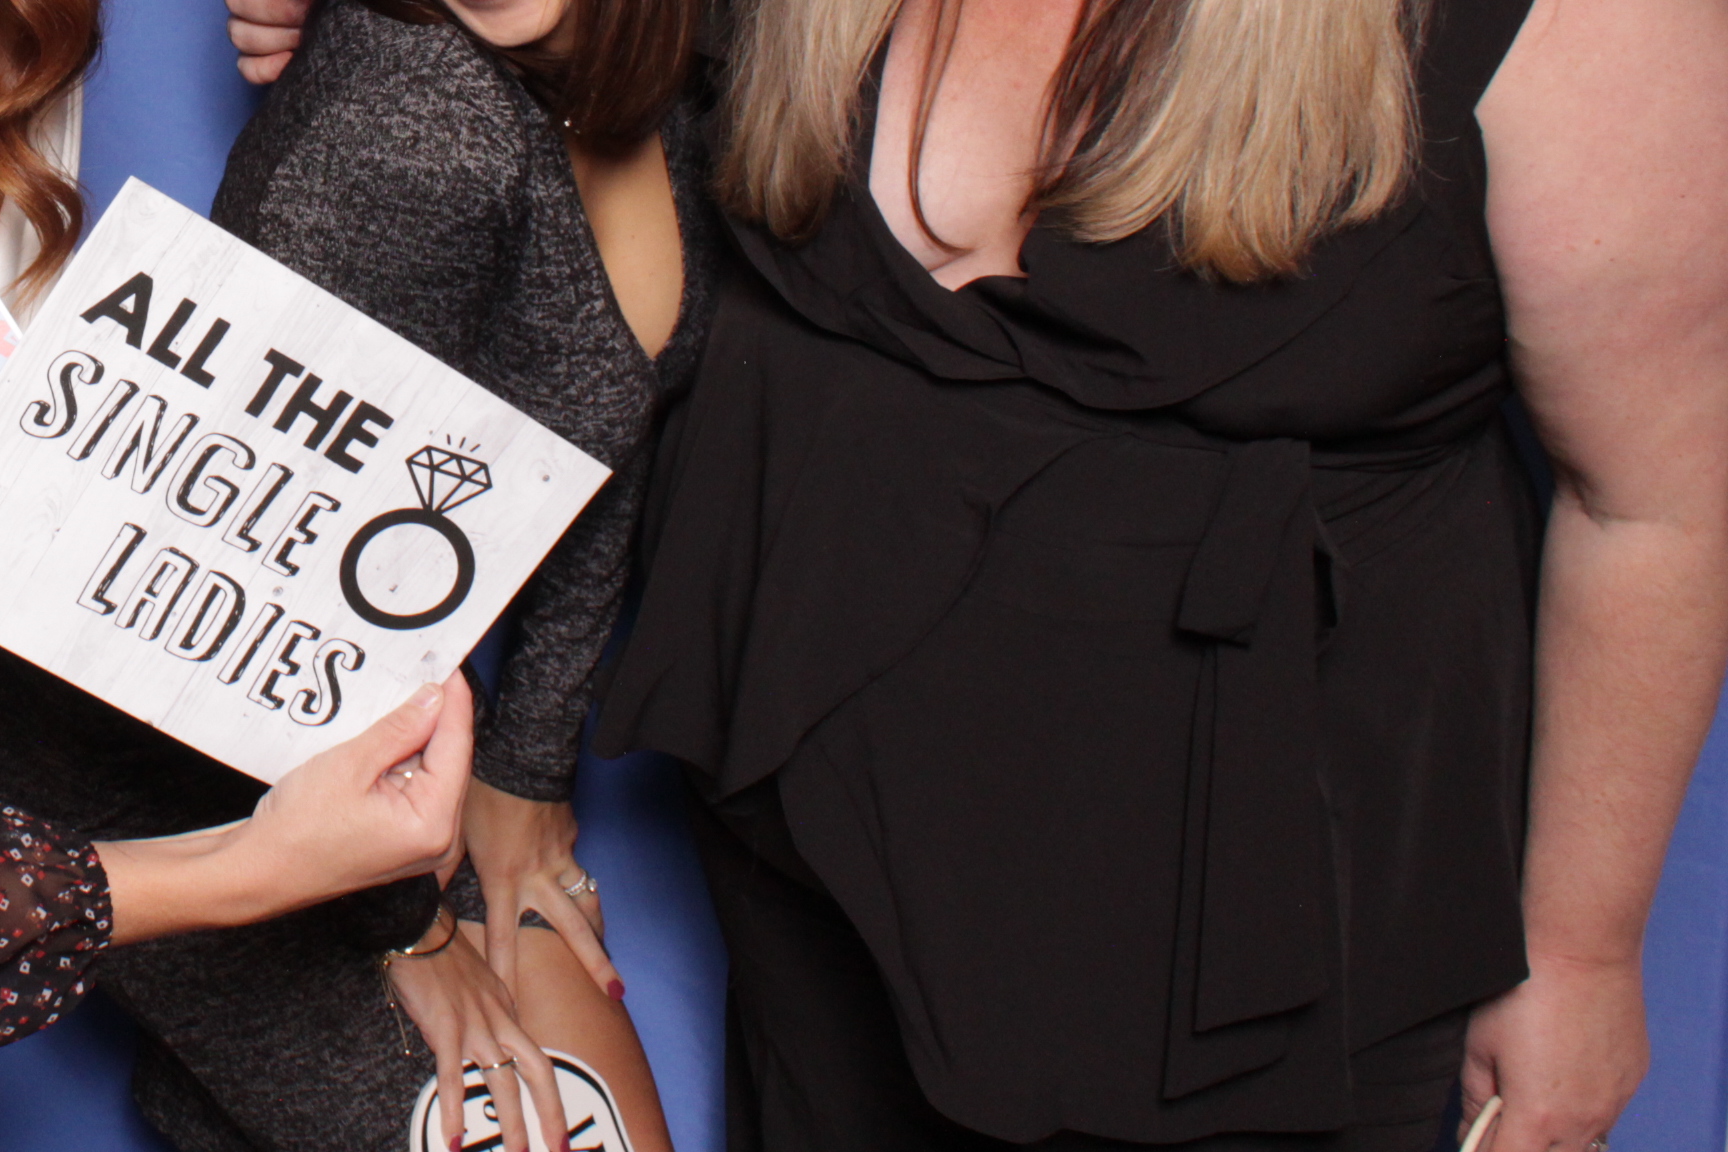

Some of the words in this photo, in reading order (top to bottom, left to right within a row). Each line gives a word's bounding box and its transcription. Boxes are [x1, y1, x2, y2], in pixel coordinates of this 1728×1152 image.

[20, 350, 342, 577] SINGLE
[80, 272, 232, 388] ALL
[245, 349, 394, 474] THE
[78, 522, 366, 726] LADIES
